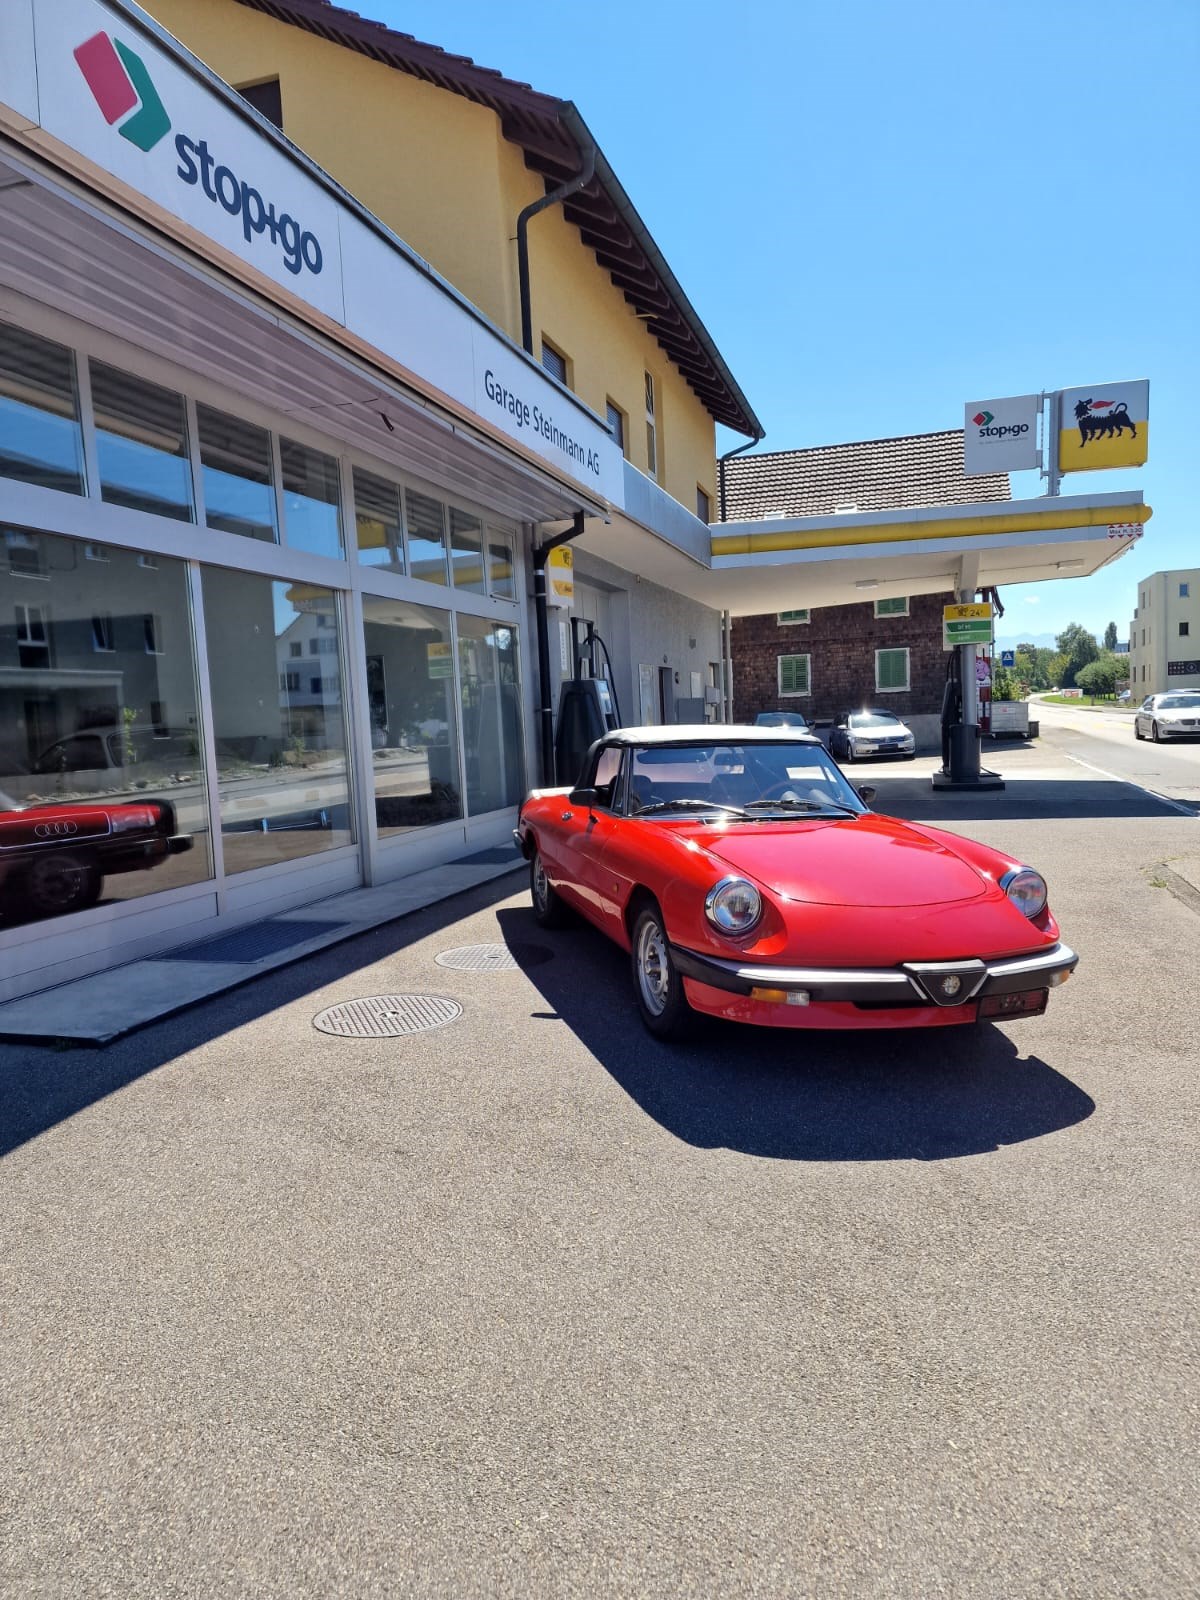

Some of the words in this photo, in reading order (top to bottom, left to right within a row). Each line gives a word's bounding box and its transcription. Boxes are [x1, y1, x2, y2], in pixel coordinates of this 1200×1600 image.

[175, 133, 323, 275] stop+go
[484, 369, 530, 428] Garage
[533, 405, 585, 464] Steinmann
[587, 447, 600, 475] AG
[979, 423, 1029, 438] stop+go
